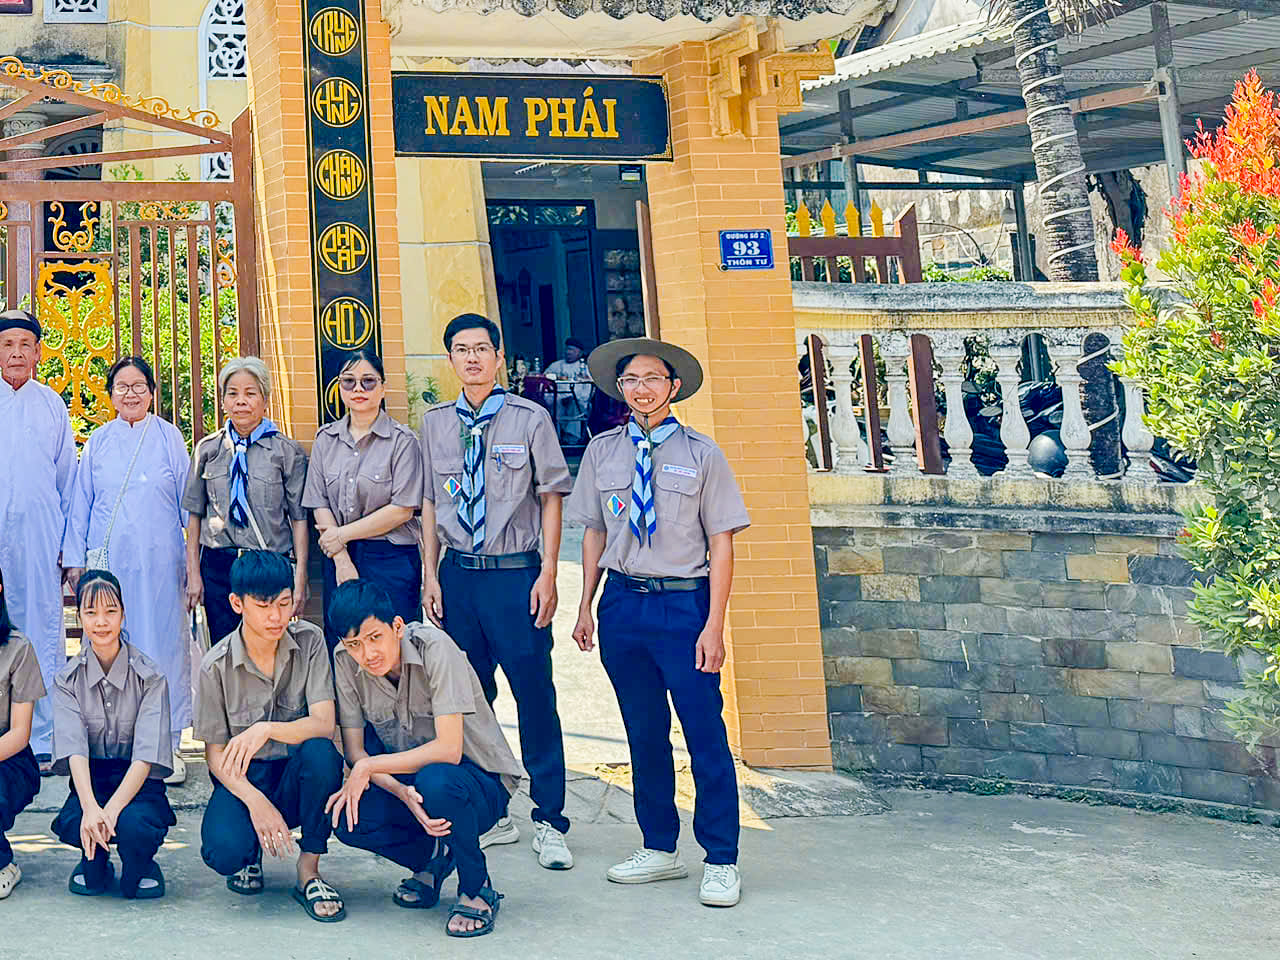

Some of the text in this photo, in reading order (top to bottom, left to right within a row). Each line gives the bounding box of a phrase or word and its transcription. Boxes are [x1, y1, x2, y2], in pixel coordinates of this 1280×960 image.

[313, 10, 356, 53] TRUNG
[424, 85, 619, 138] NAM PHÁI
[733, 241, 760, 255] 93
